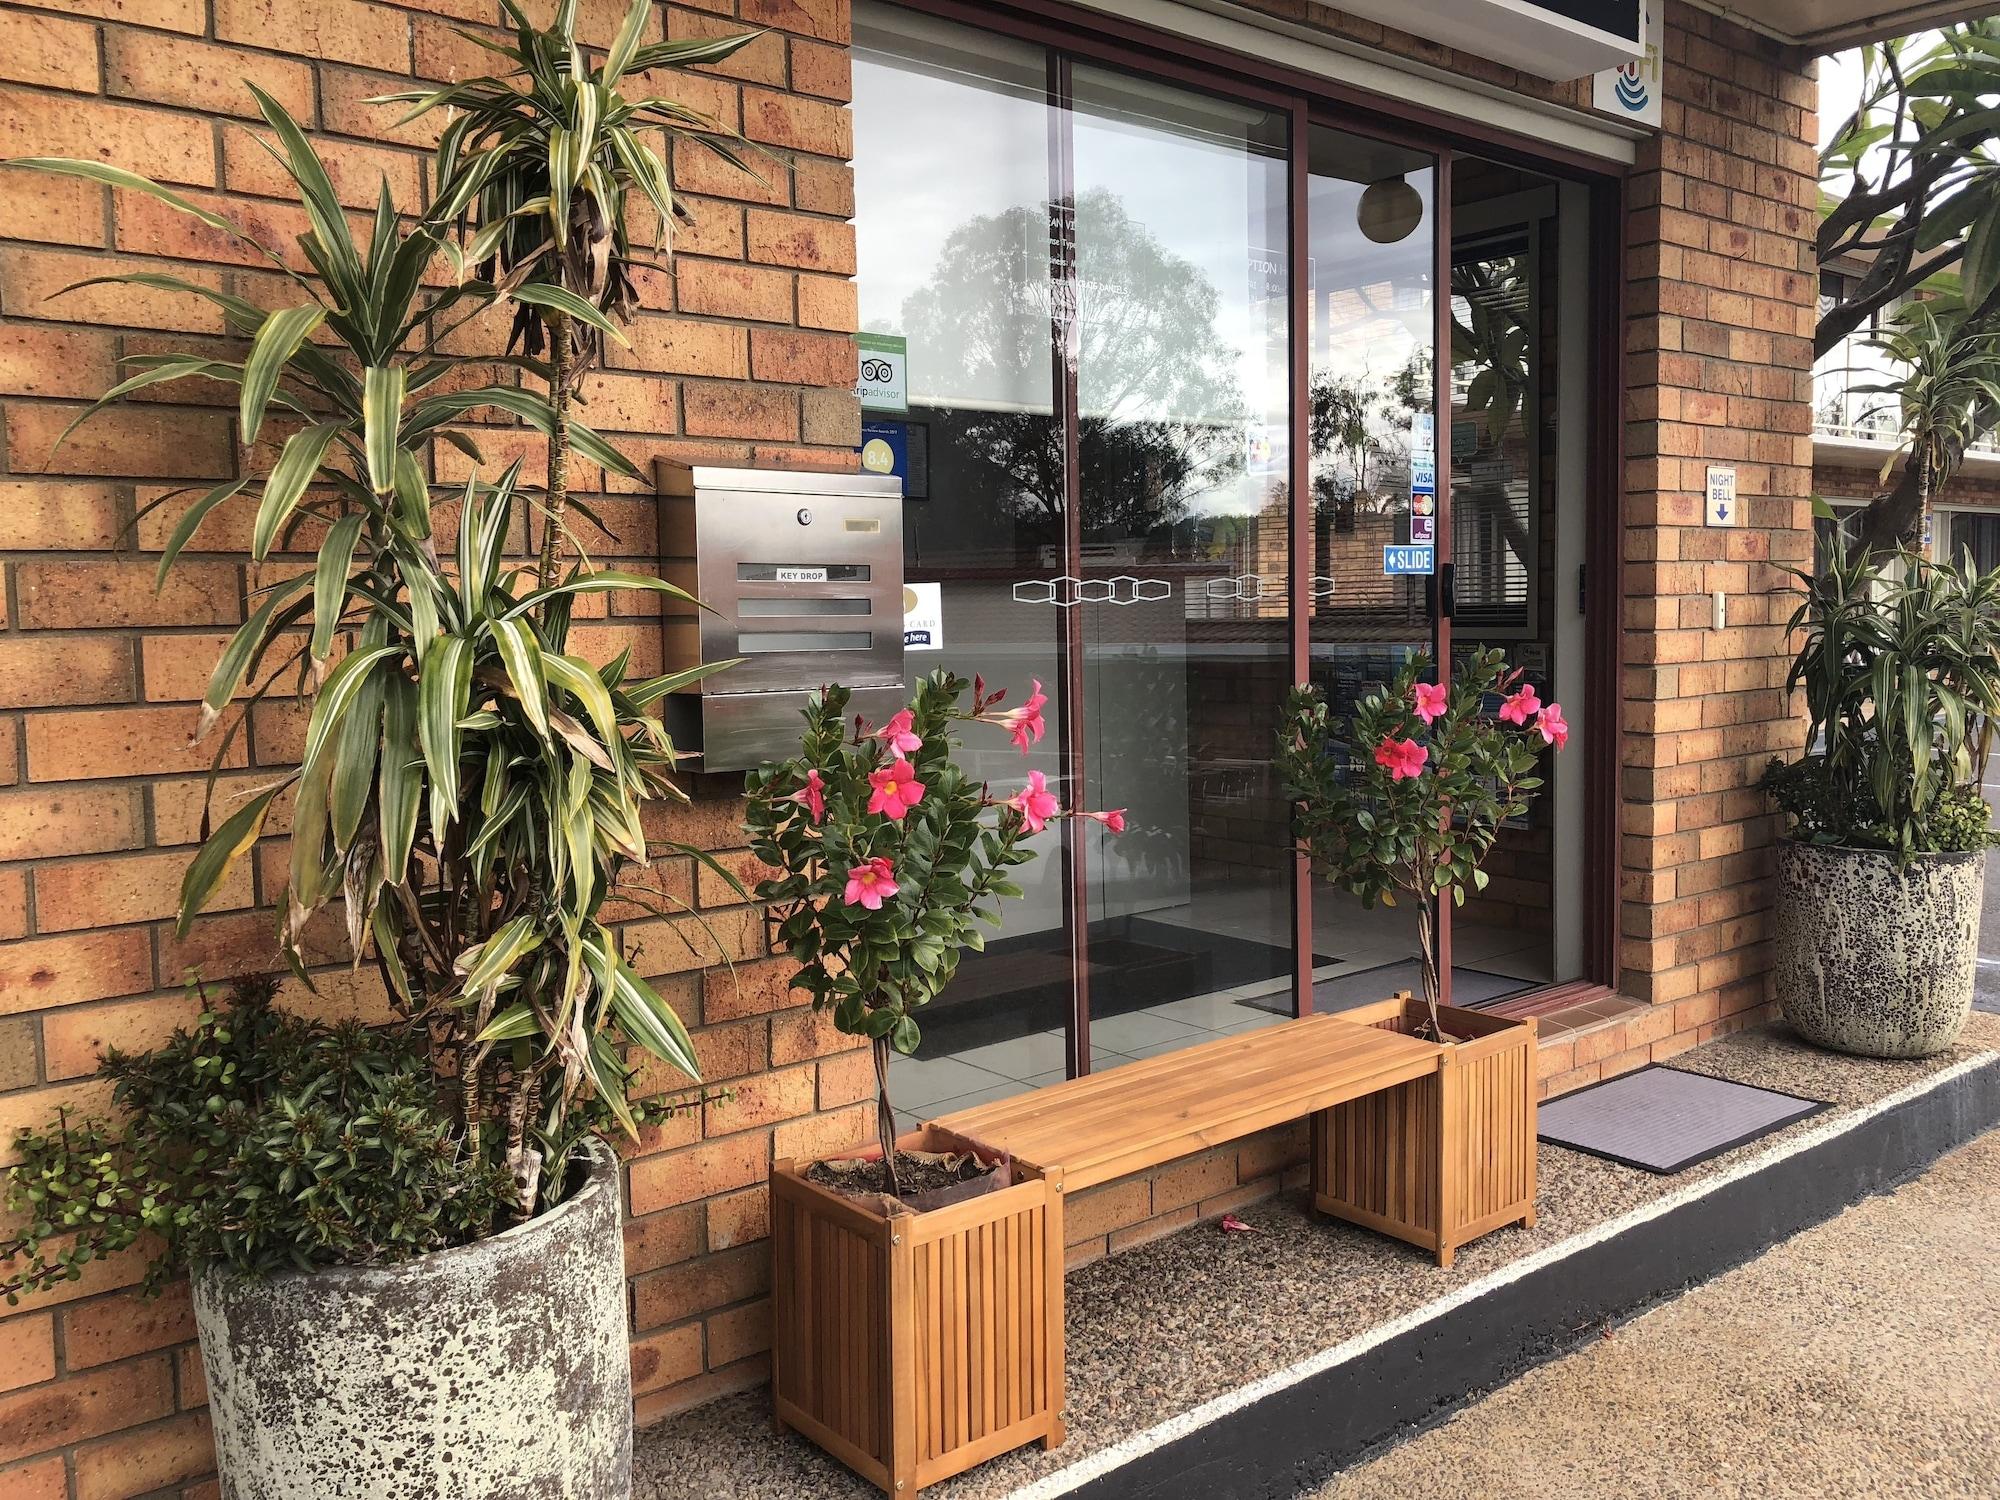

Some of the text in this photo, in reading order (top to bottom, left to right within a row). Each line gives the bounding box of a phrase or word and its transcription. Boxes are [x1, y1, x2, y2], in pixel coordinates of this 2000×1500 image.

[867, 450, 888, 466] 8.4
[1415, 472, 1433, 483] VISA
[1710, 473, 1734, 486] NIGHT
[1712, 488, 1732, 501] BELL
[1397, 550, 1431, 570] SLIDE
[780, 572, 824, 580] KEY DROP
[909, 619, 936, 628] CARD
[910, 632, 927, 642] here
